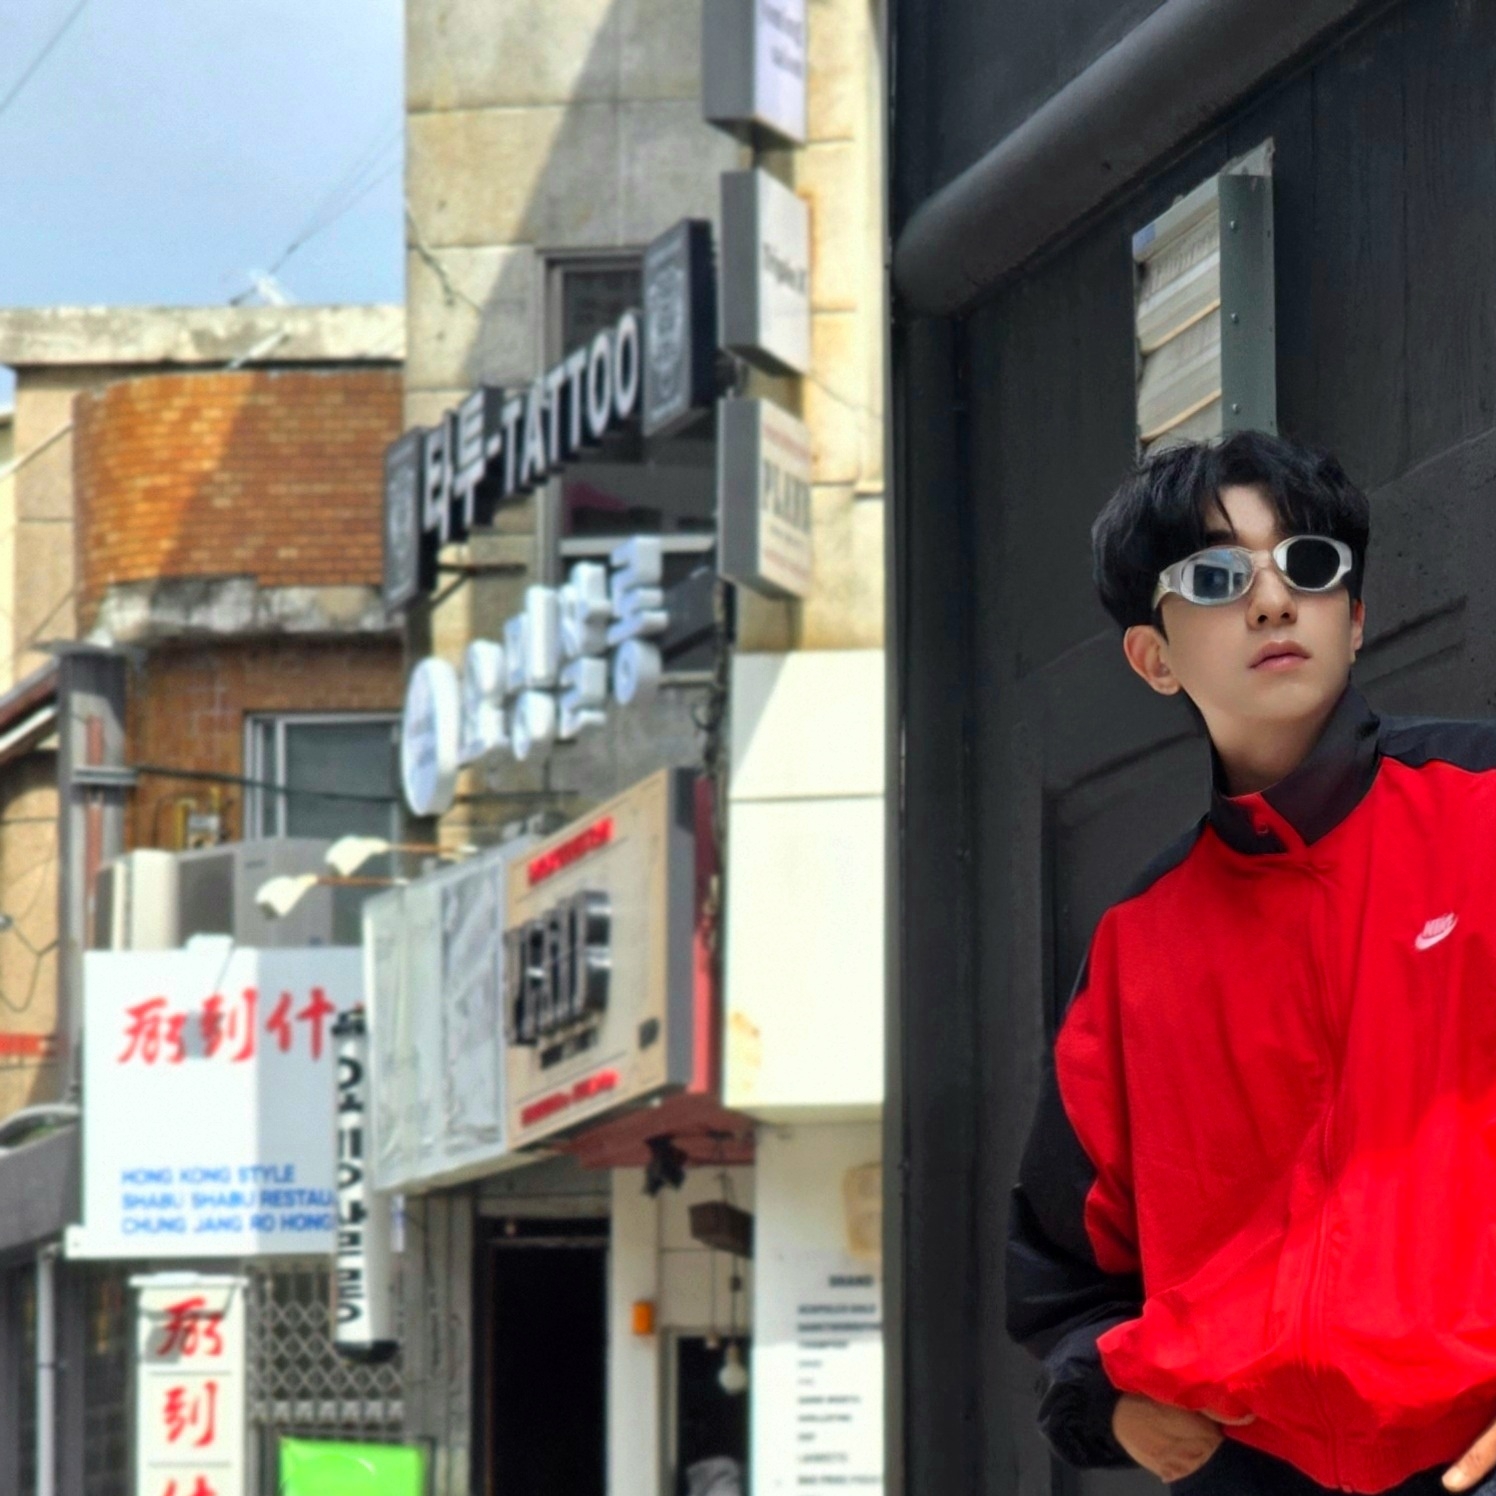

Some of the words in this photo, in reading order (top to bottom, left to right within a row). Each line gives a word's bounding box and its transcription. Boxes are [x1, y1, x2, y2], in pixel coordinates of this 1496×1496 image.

[121, 1168, 173, 1185] HONG
[179, 1166, 231, 1185] KONG
[238, 1164, 295, 1185] STYLE
[121, 1214, 186, 1234] CHUNG
[193, 1213, 242, 1233] JANG
